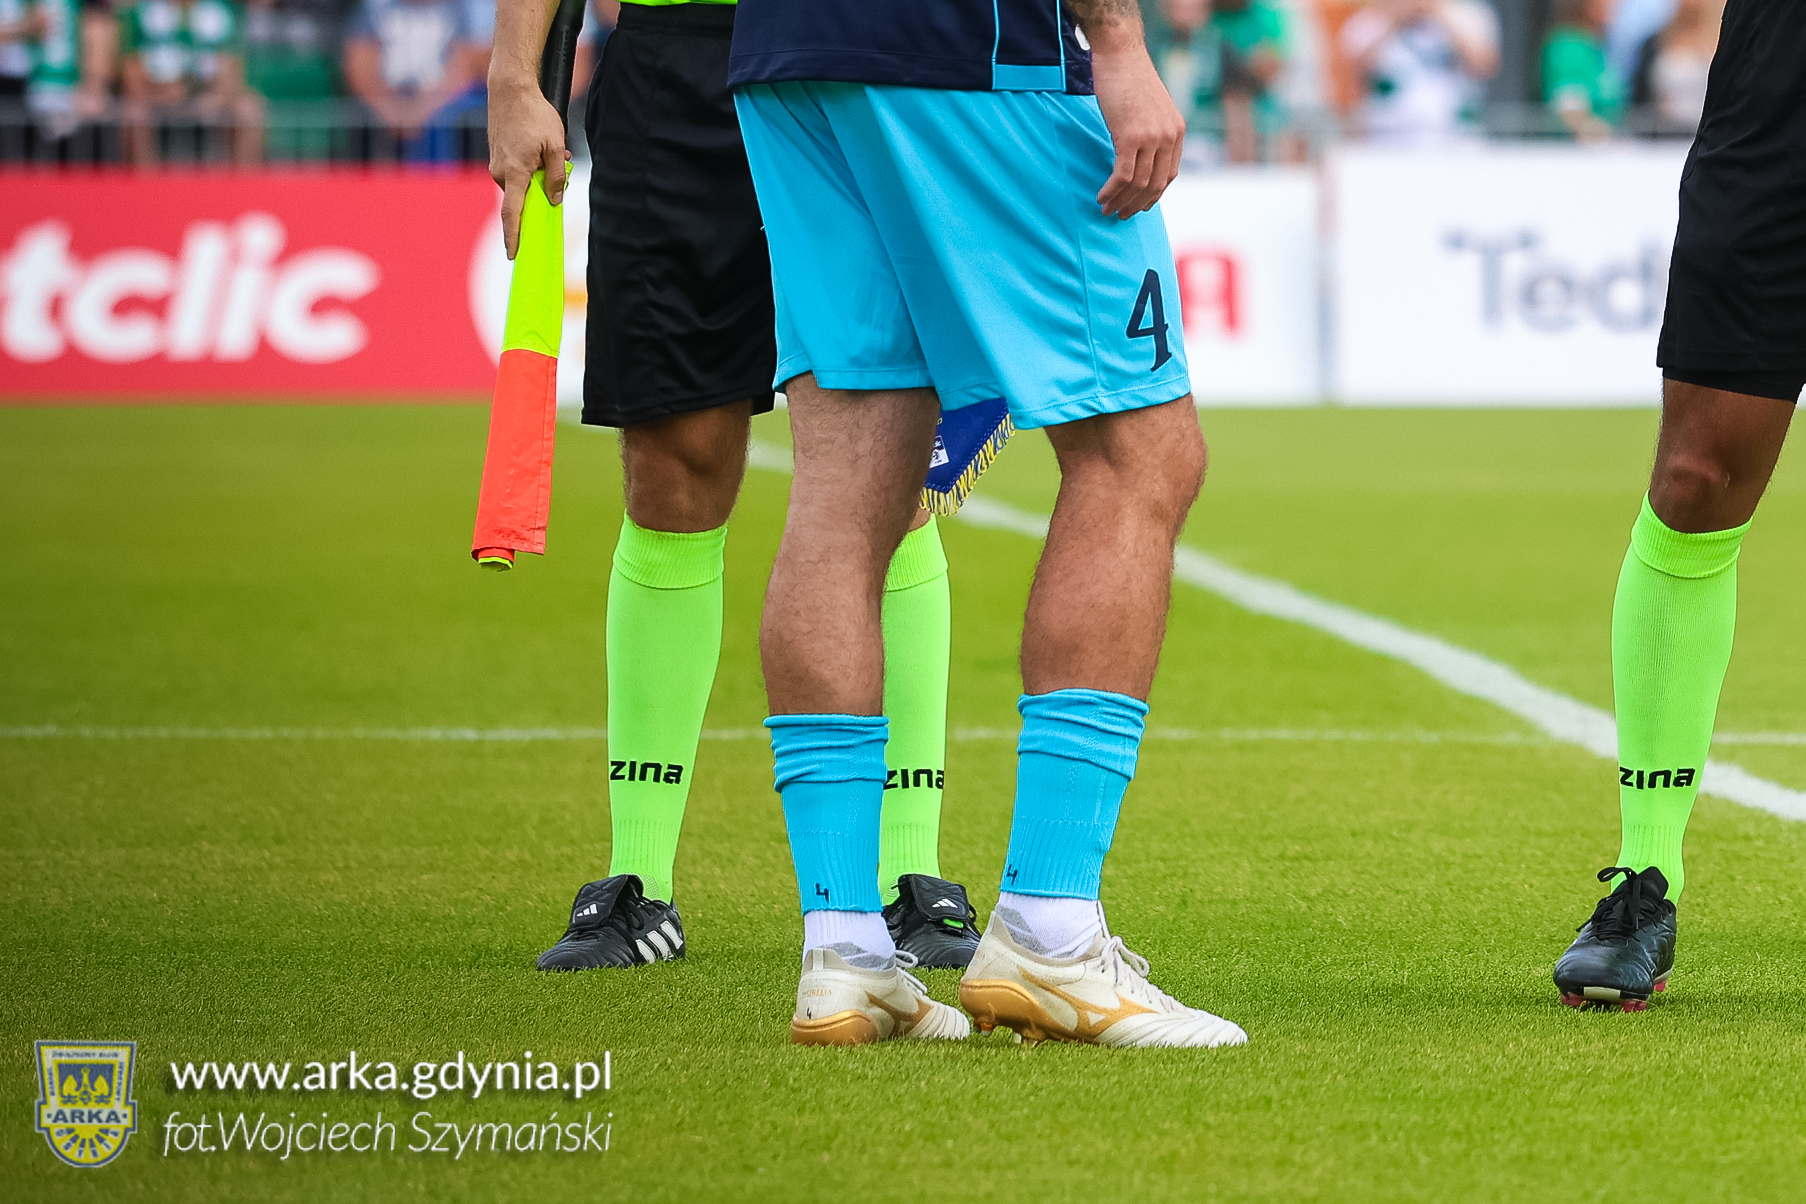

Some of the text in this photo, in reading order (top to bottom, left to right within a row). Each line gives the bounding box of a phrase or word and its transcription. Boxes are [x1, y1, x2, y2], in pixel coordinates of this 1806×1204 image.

[1125, 267, 1173, 374] 4
[609, 760, 684, 785] zina
[1618, 766, 1696, 790] zina
[1006, 863, 1018, 886] 4
[815, 883, 831, 903] 4
